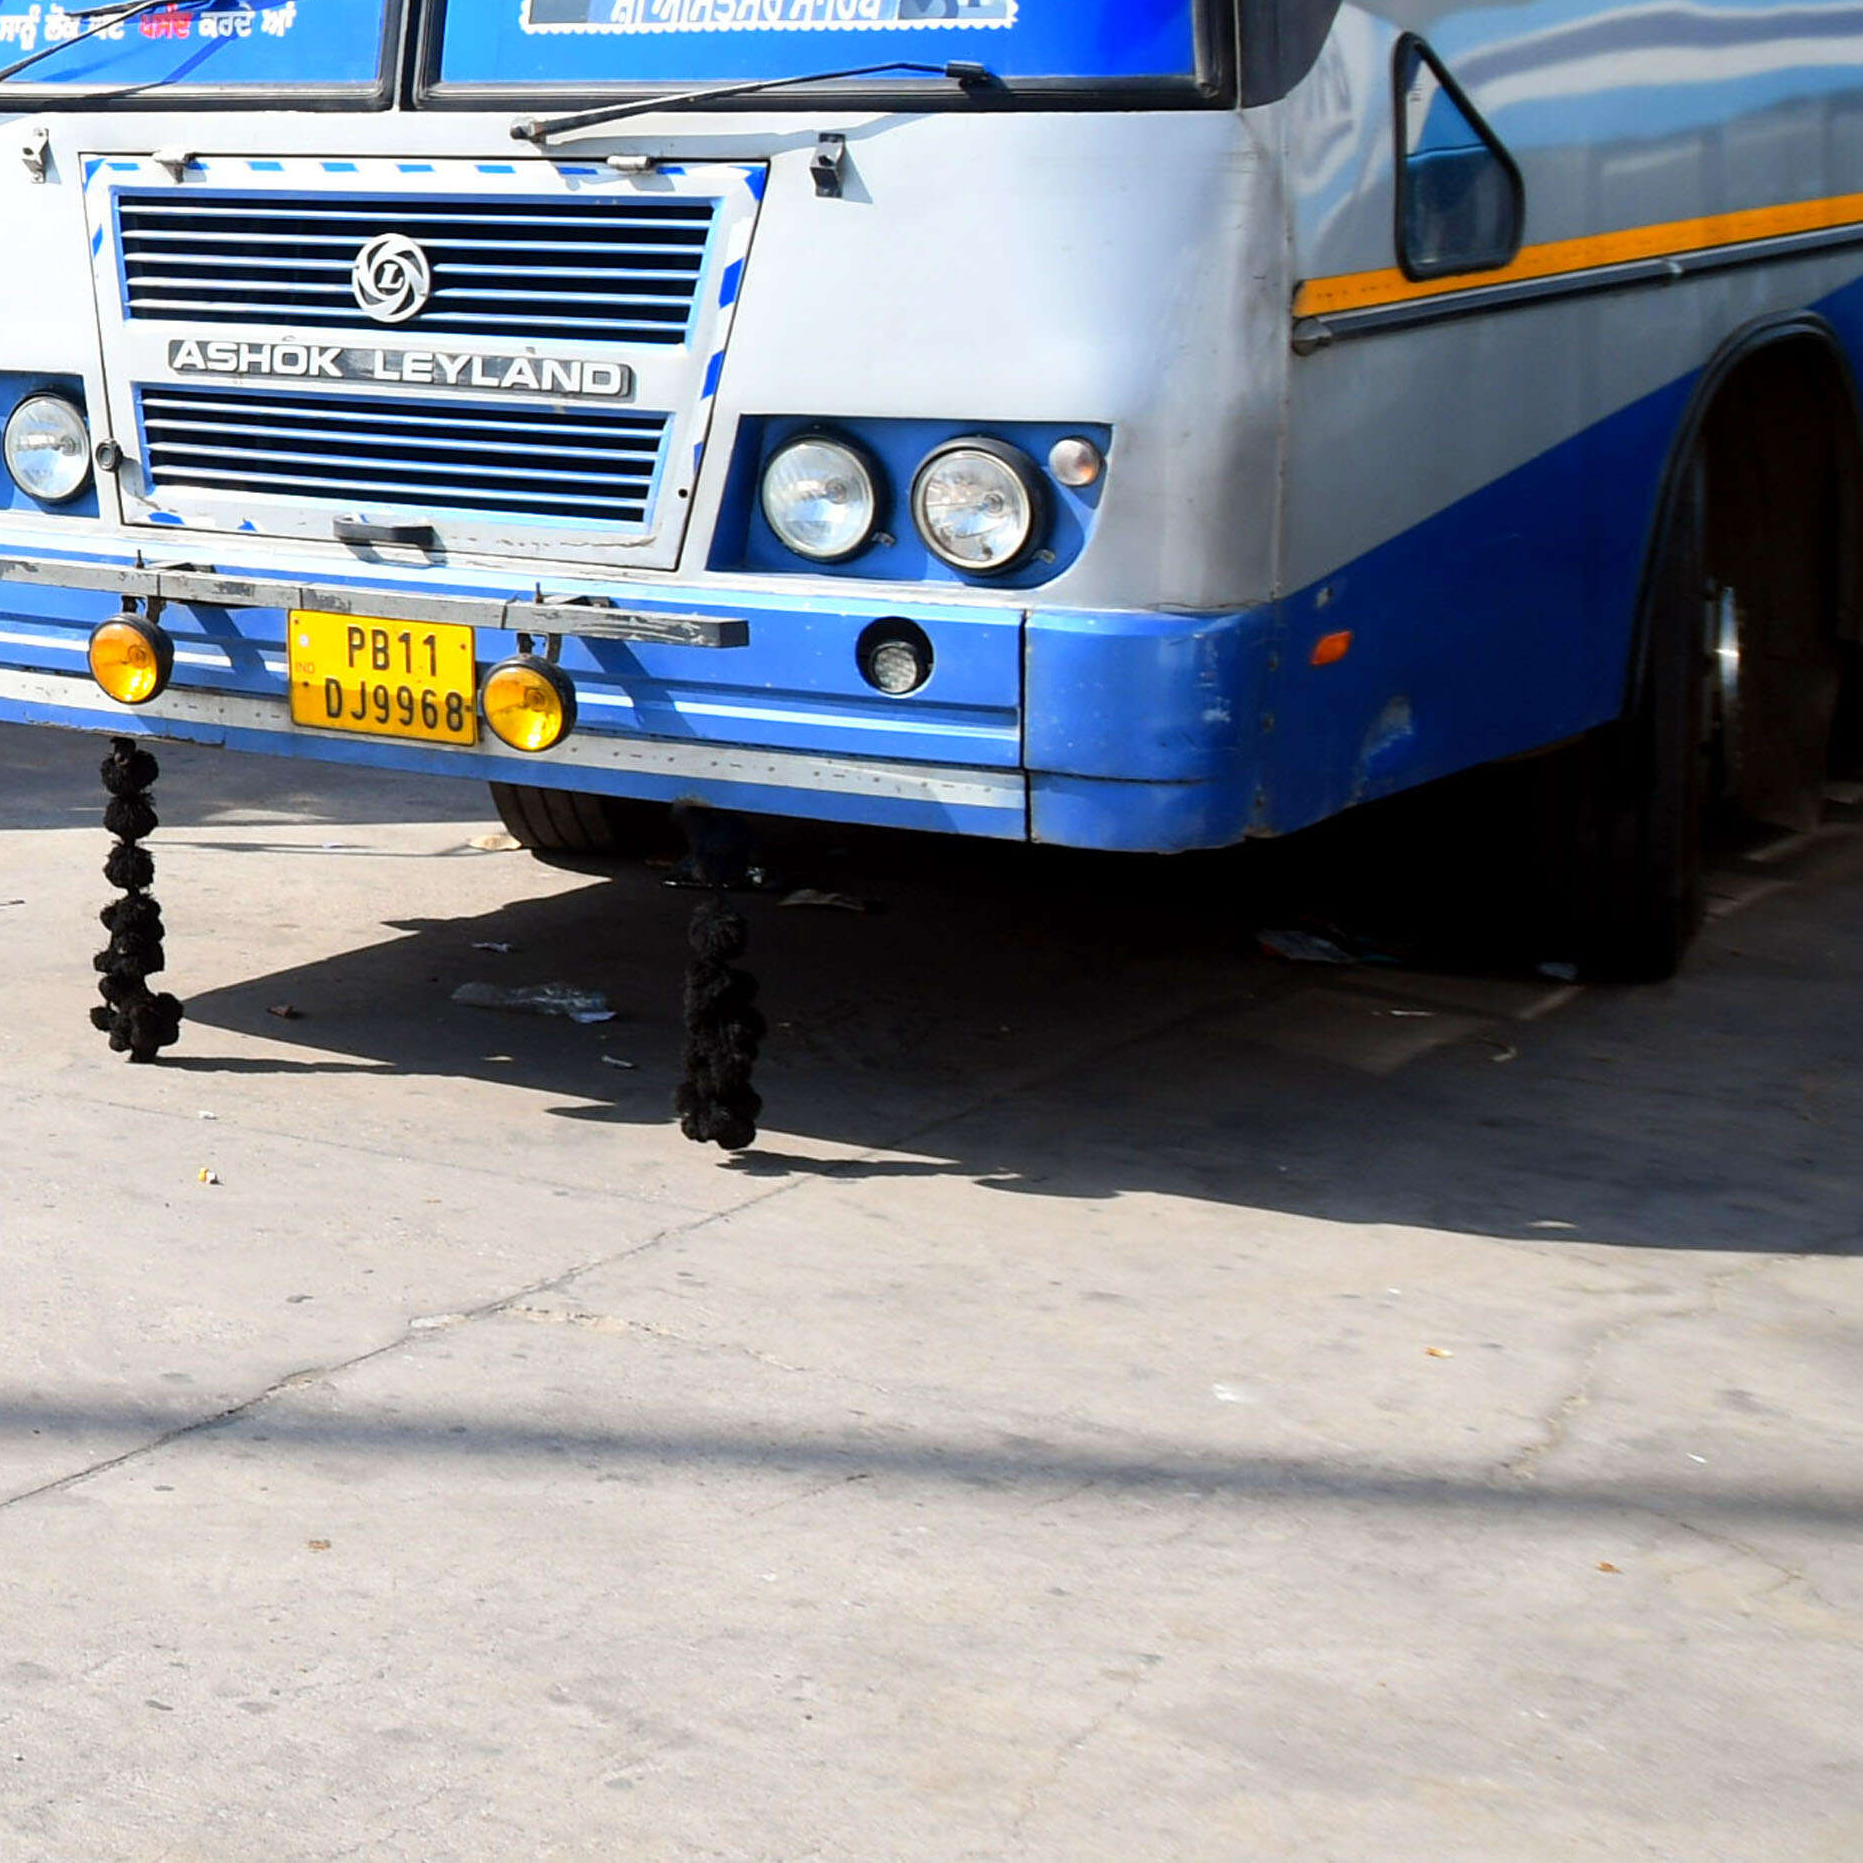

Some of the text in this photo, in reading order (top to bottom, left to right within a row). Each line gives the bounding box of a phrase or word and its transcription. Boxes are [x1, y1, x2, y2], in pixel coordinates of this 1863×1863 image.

[172, 339, 625, 395] ASHOK LEYLAND
[346, 626, 438, 677] PB11
[324, 678, 465, 733] DJ9968
